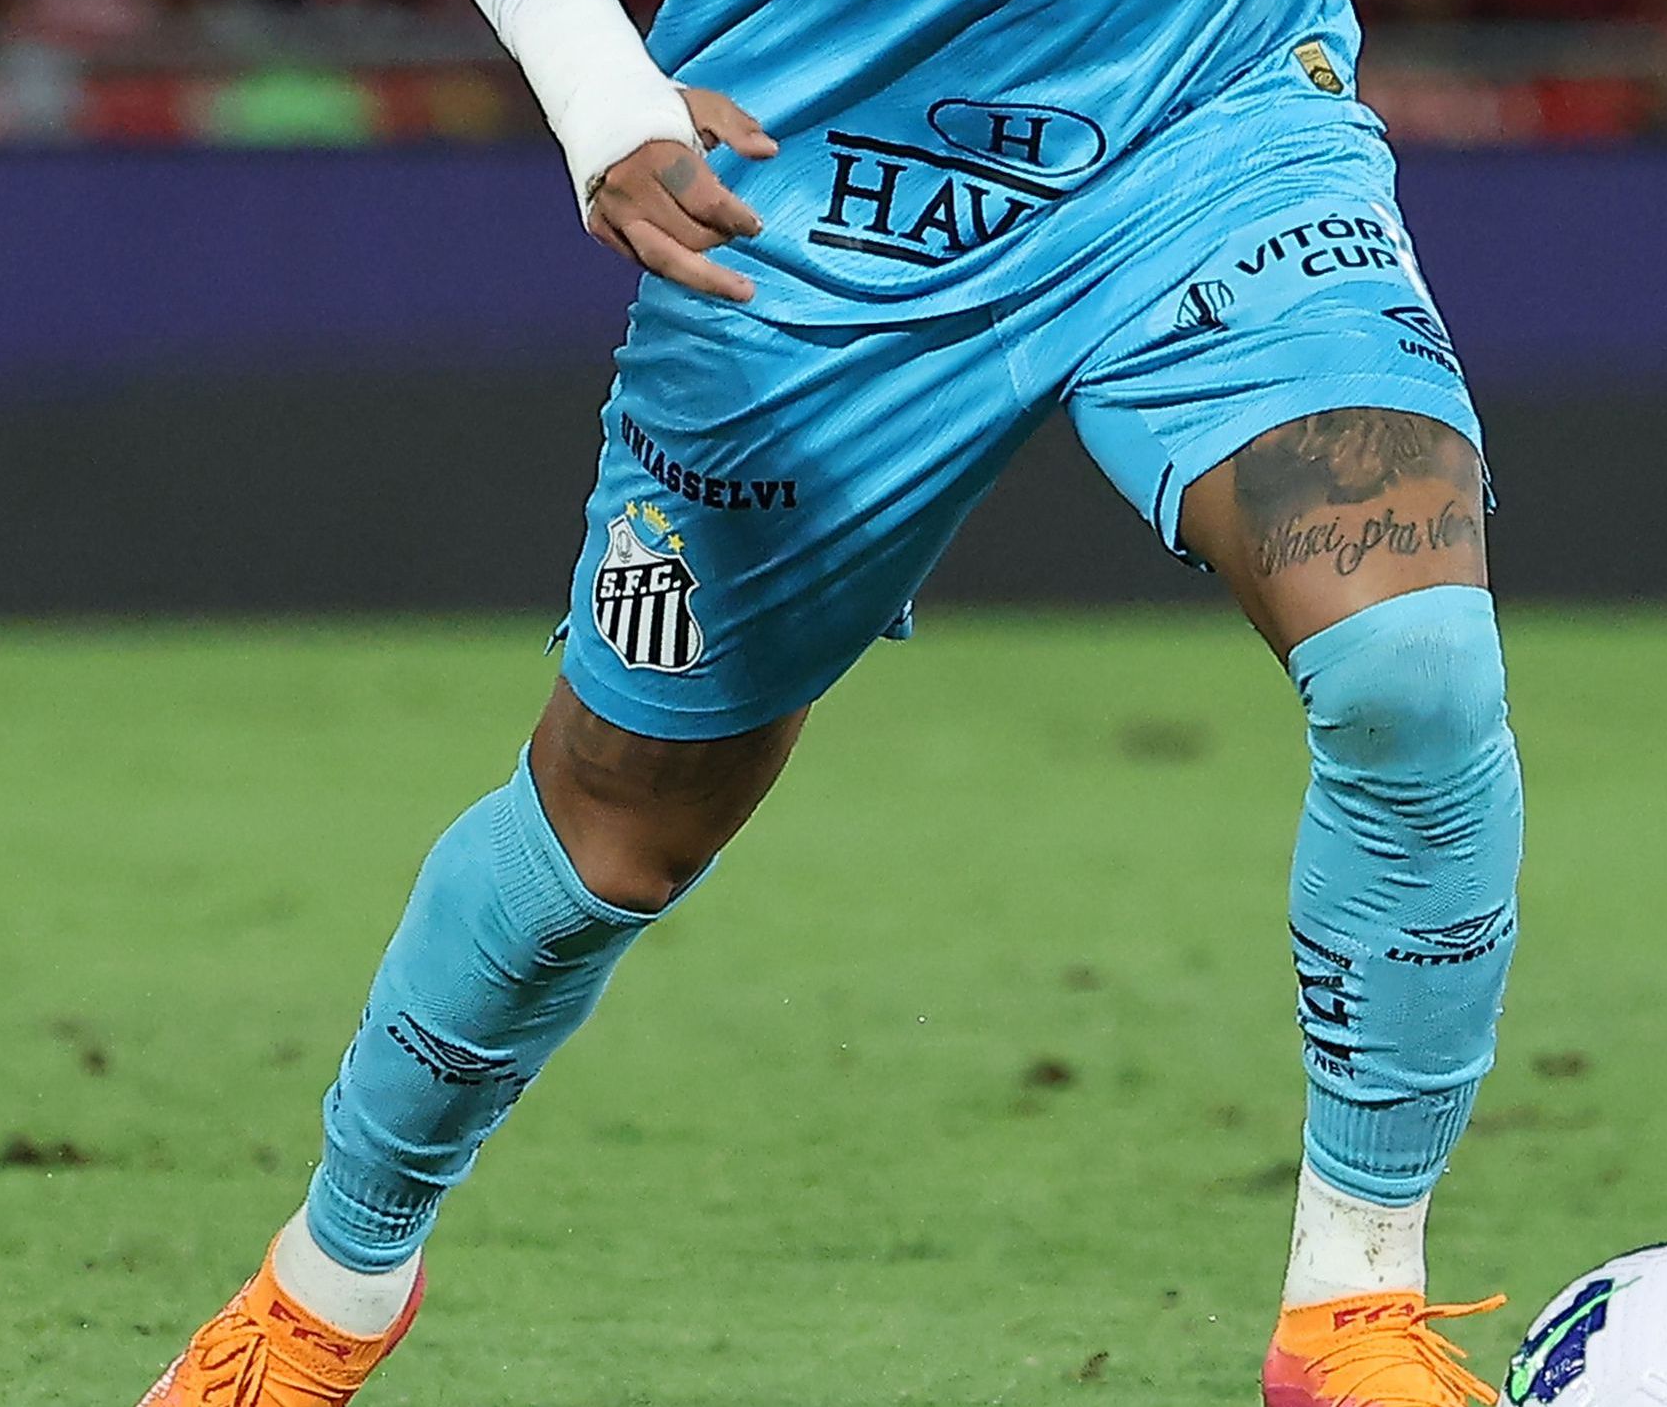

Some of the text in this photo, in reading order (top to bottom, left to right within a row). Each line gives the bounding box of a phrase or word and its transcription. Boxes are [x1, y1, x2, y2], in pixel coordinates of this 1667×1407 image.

[987, 113, 1052, 167] H
[818, 151, 1036, 252] HAV
[1397, 338, 1459, 374] umb
[620, 410, 797, 512] UNIASSELVI
